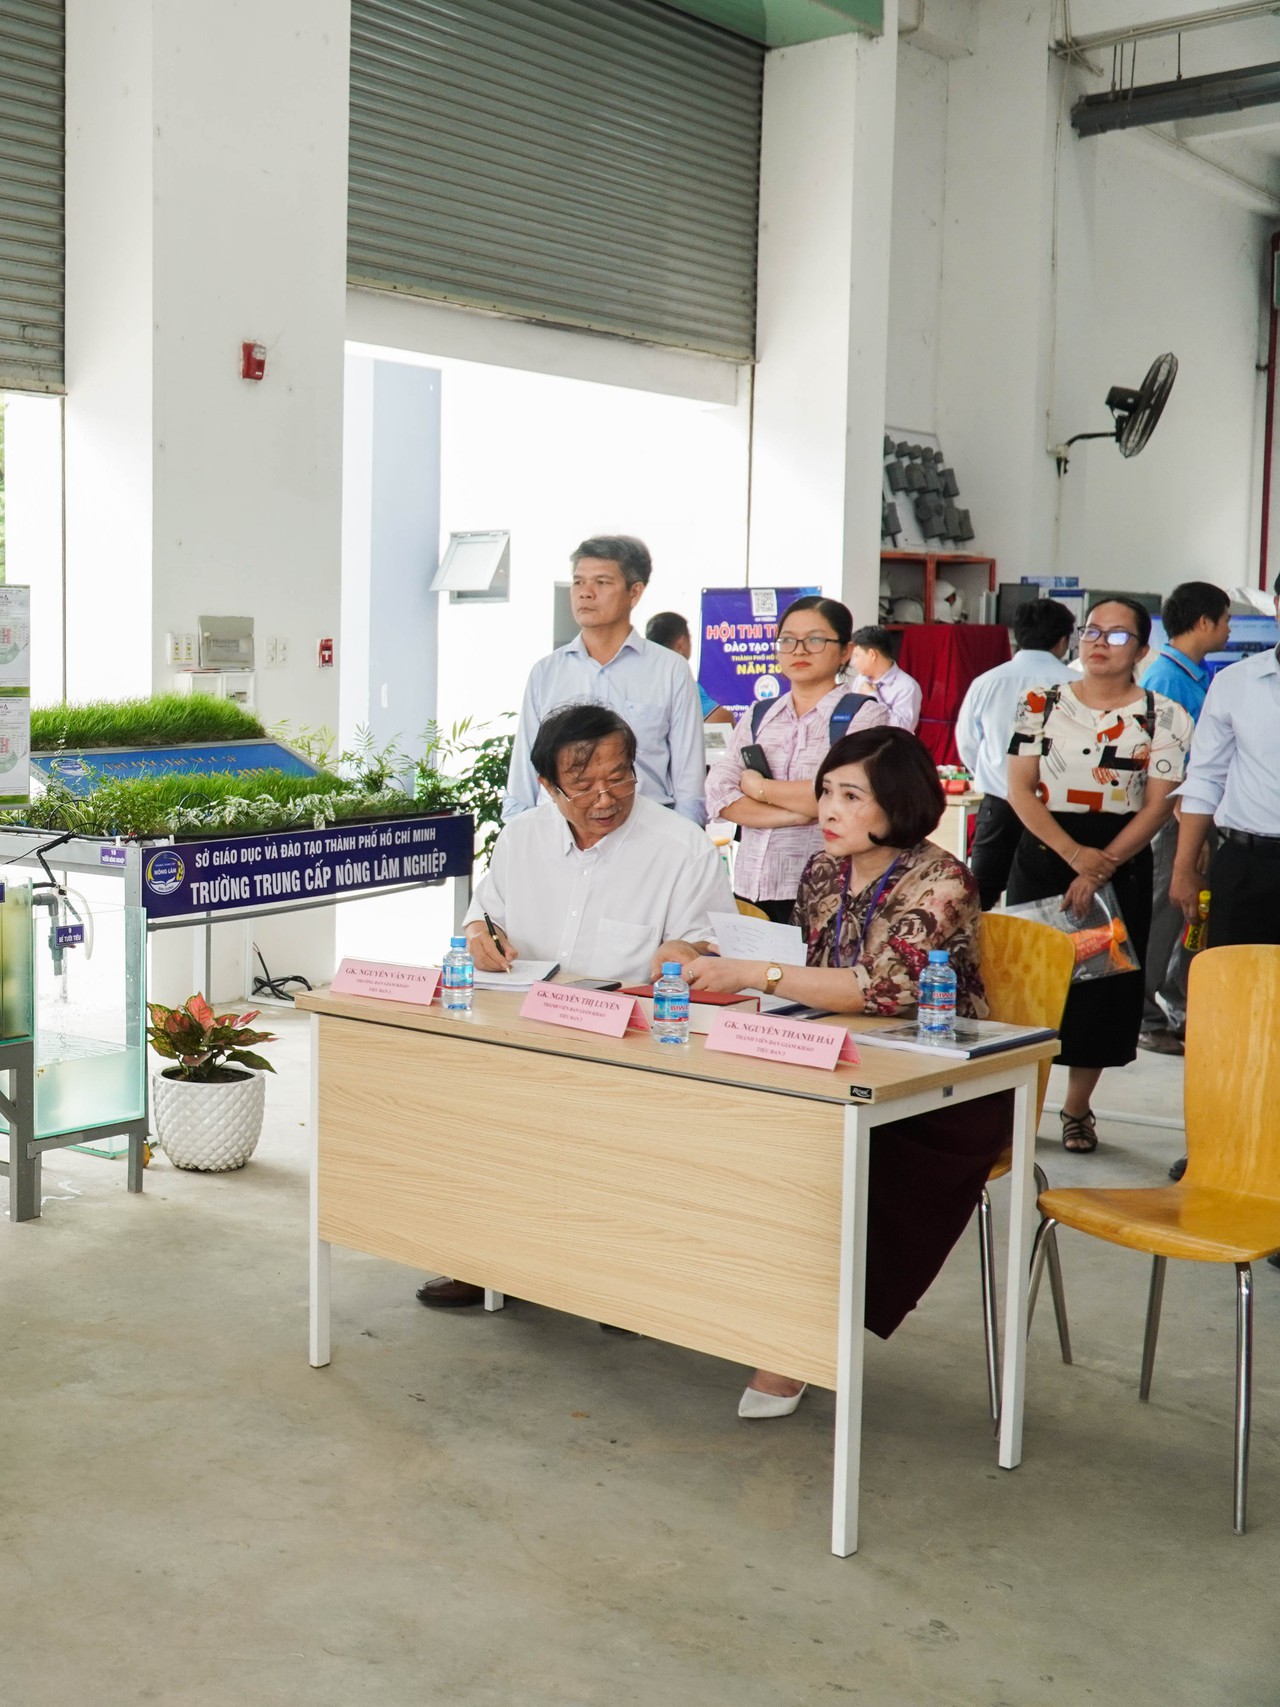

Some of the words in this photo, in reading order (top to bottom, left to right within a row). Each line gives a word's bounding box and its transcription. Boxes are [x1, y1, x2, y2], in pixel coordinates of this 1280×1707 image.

[707, 621, 735, 643] HỘI
[737, 624, 762, 639] THI
[724, 641, 748, 653] ĐÀO
[749, 642, 769, 654] TẠO
[737, 661, 766, 675] NĂM
[768, 664, 782, 674] 20
[195, 848, 210, 868] SỞ
[213, 847, 237, 866] GIÁO
[241, 846, 262, 865] DỤC
[265, 842, 278, 860] VÀ
[281, 840, 301, 858] ĐÀO
[304, 840, 323, 858] TẠO
[325, 835, 356, 853] THÀNH
[358, 829, 378, 849] PHỐ
[380, 827, 393, 846] HỒ
[395, 827, 411, 845] CHÍ
[413, 828, 436, 842] MINH
[190, 873, 250, 905] TRƯỜNG
[254, 870, 301, 897] TRUNG
[304, 859, 332, 891] CẤP
[335, 858, 371, 886] NÔNG
[374, 854, 400, 881] LÂM
[404, 848, 447, 877] NGHIỆP
[537, 990, 548, 998] GK.
[724, 1020, 740, 1030] GK.
[743, 1023, 779, 1036] NGUYỄN
[782, 1030, 815, 1042] THANH
